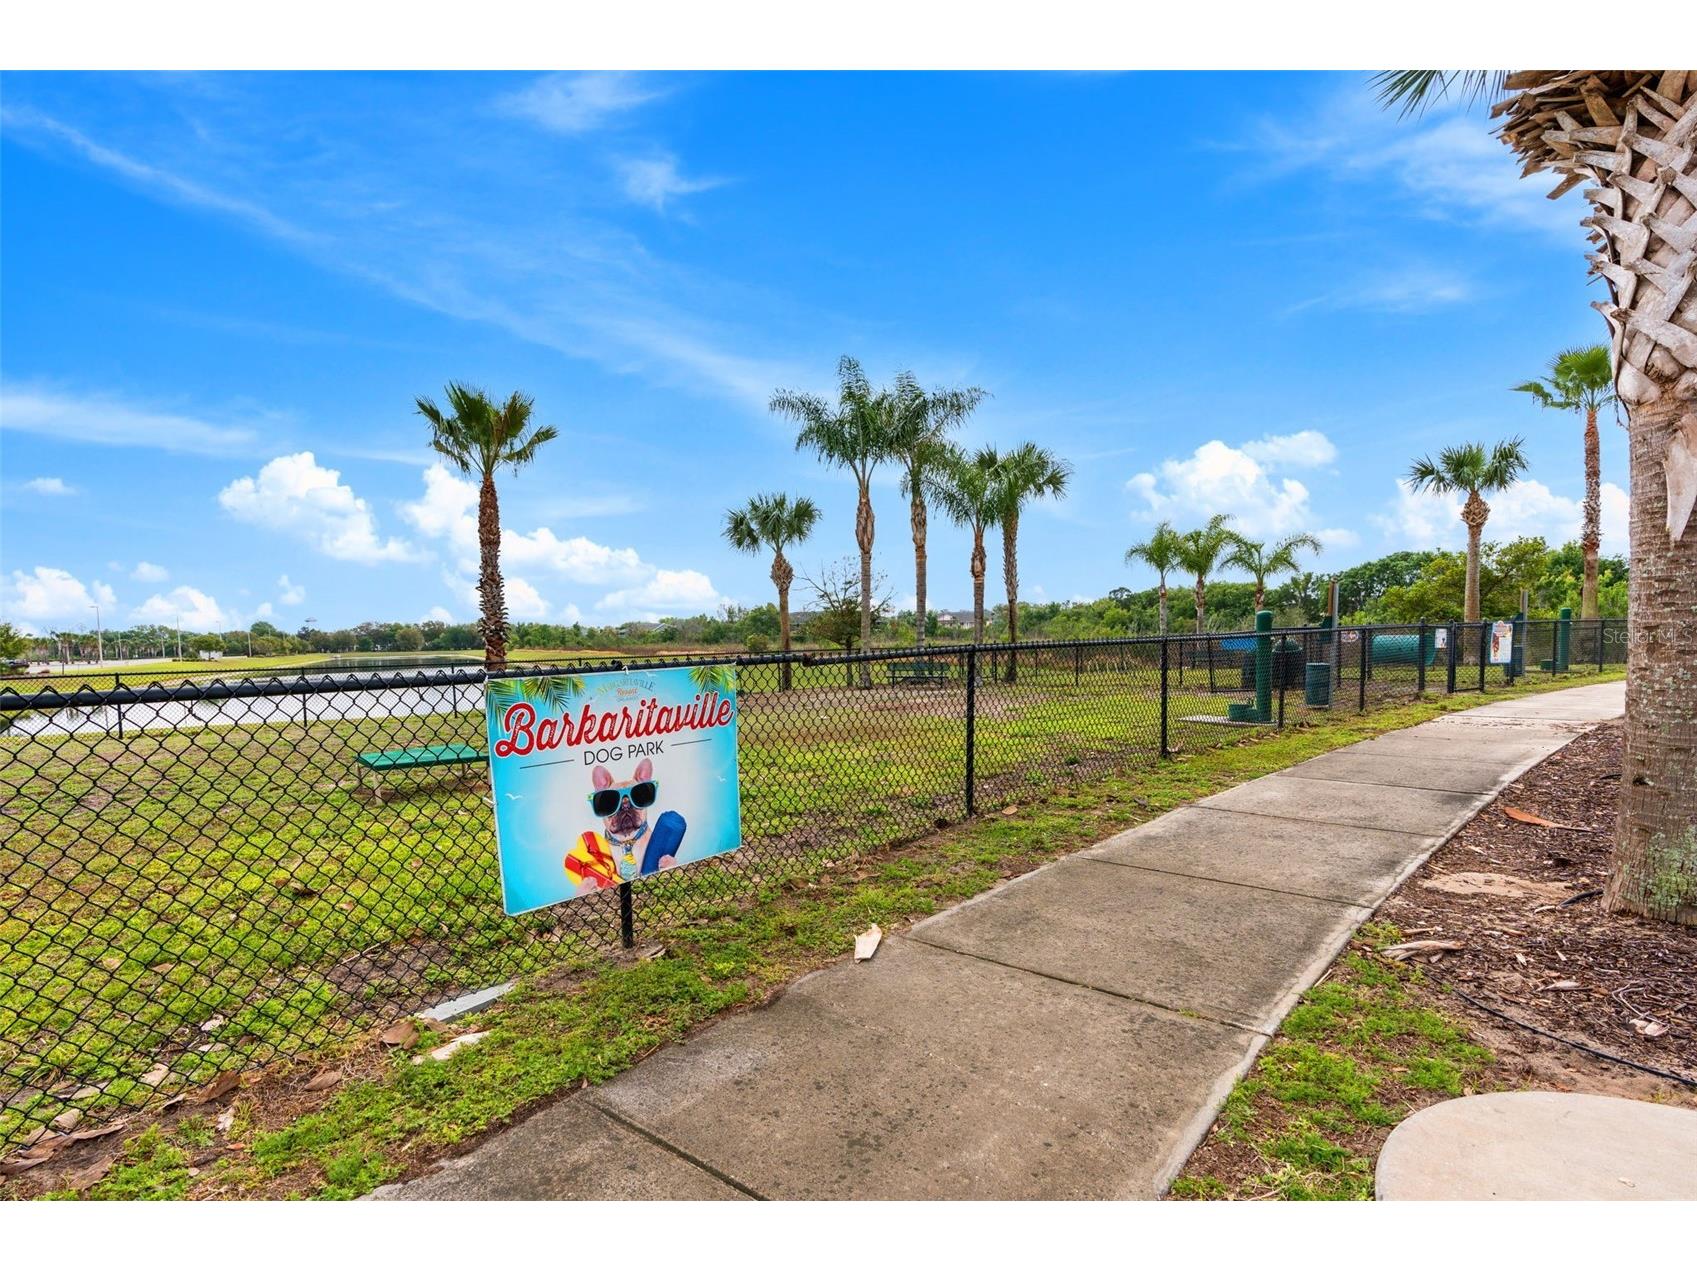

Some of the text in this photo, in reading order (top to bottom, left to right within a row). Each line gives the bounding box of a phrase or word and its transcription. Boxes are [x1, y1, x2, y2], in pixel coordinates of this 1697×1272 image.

[494, 691, 736, 758] Barkaritaville
[584, 740, 665, 766] DOG PARK
